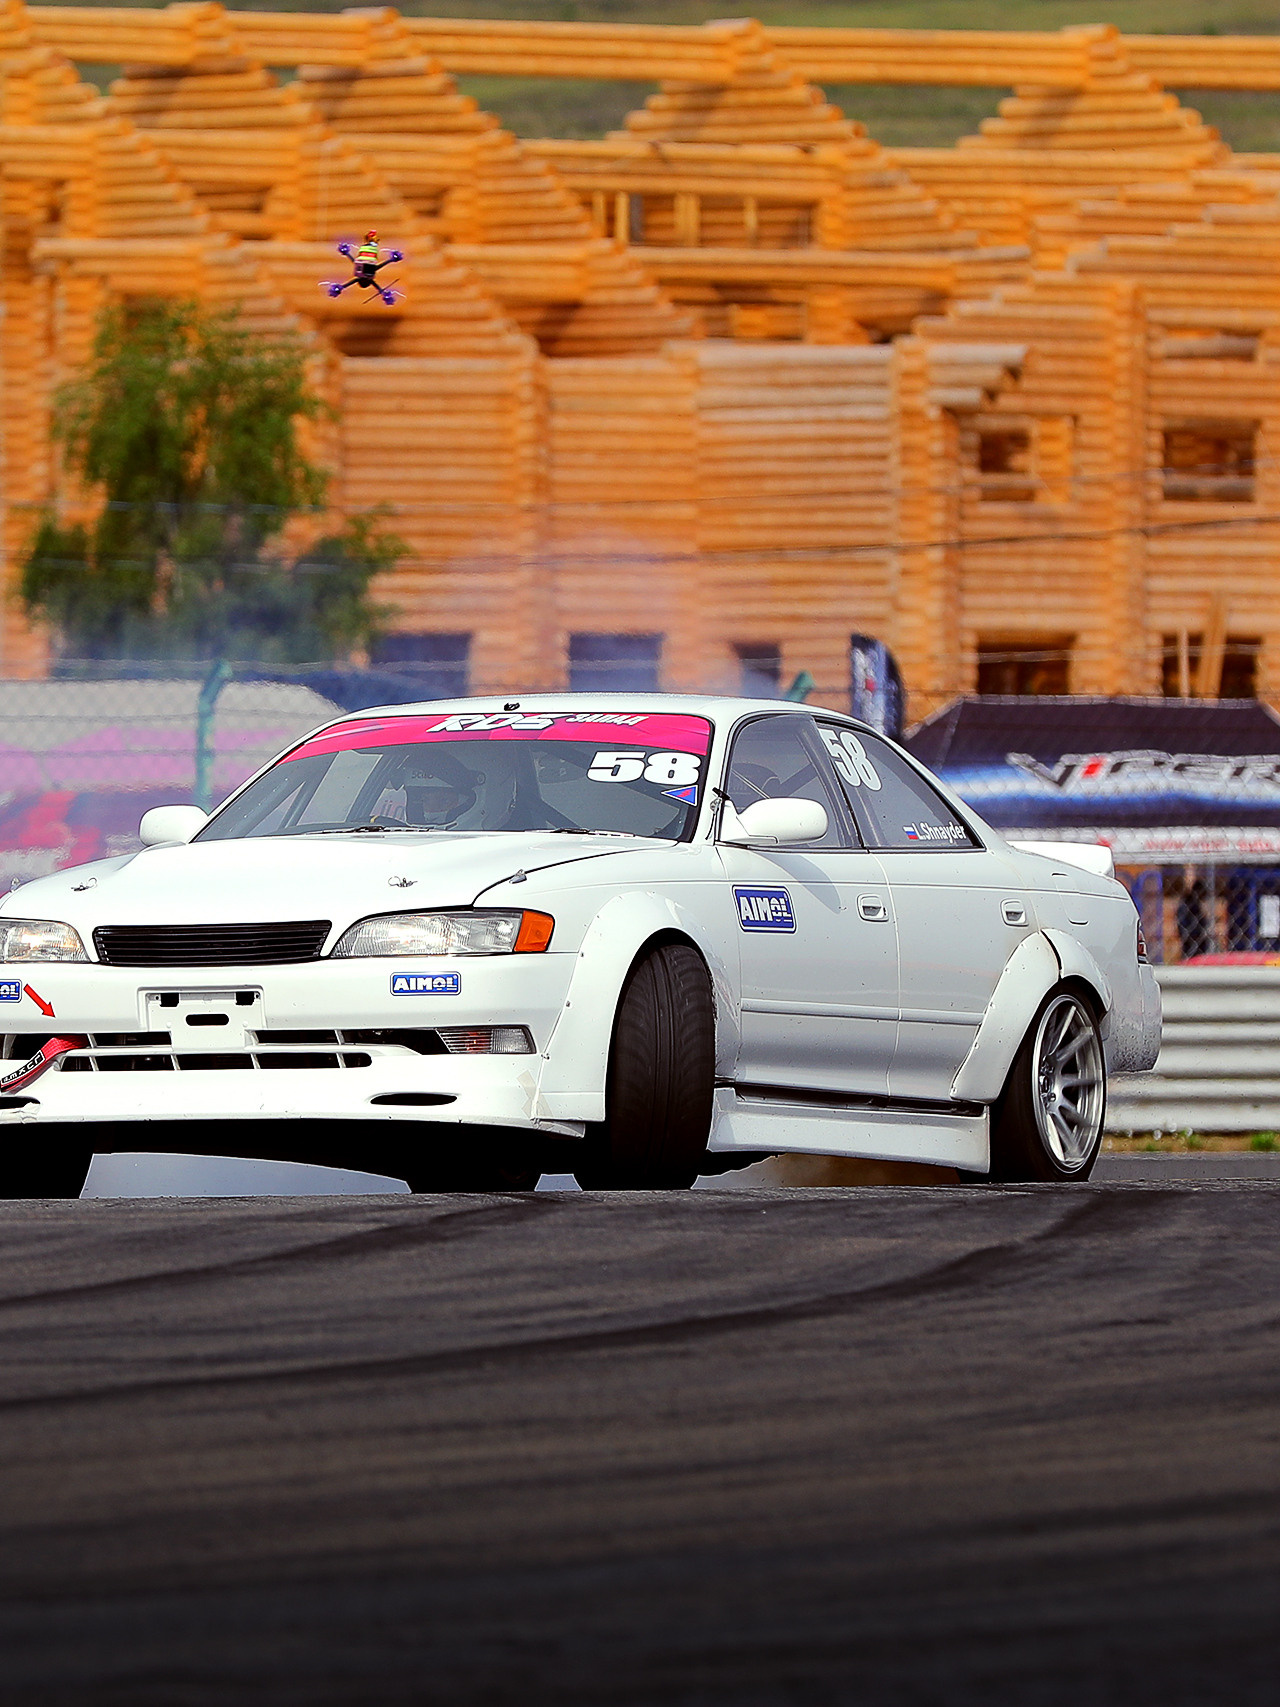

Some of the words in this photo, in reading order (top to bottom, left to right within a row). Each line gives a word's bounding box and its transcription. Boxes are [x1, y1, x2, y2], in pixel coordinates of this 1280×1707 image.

[426, 713, 574, 732] RDS
[587, 751, 702, 785] 58
[819, 729, 882, 791] 58
[740, 896, 792, 923] AIMOL
[393, 974, 458, 991] AIMOL
